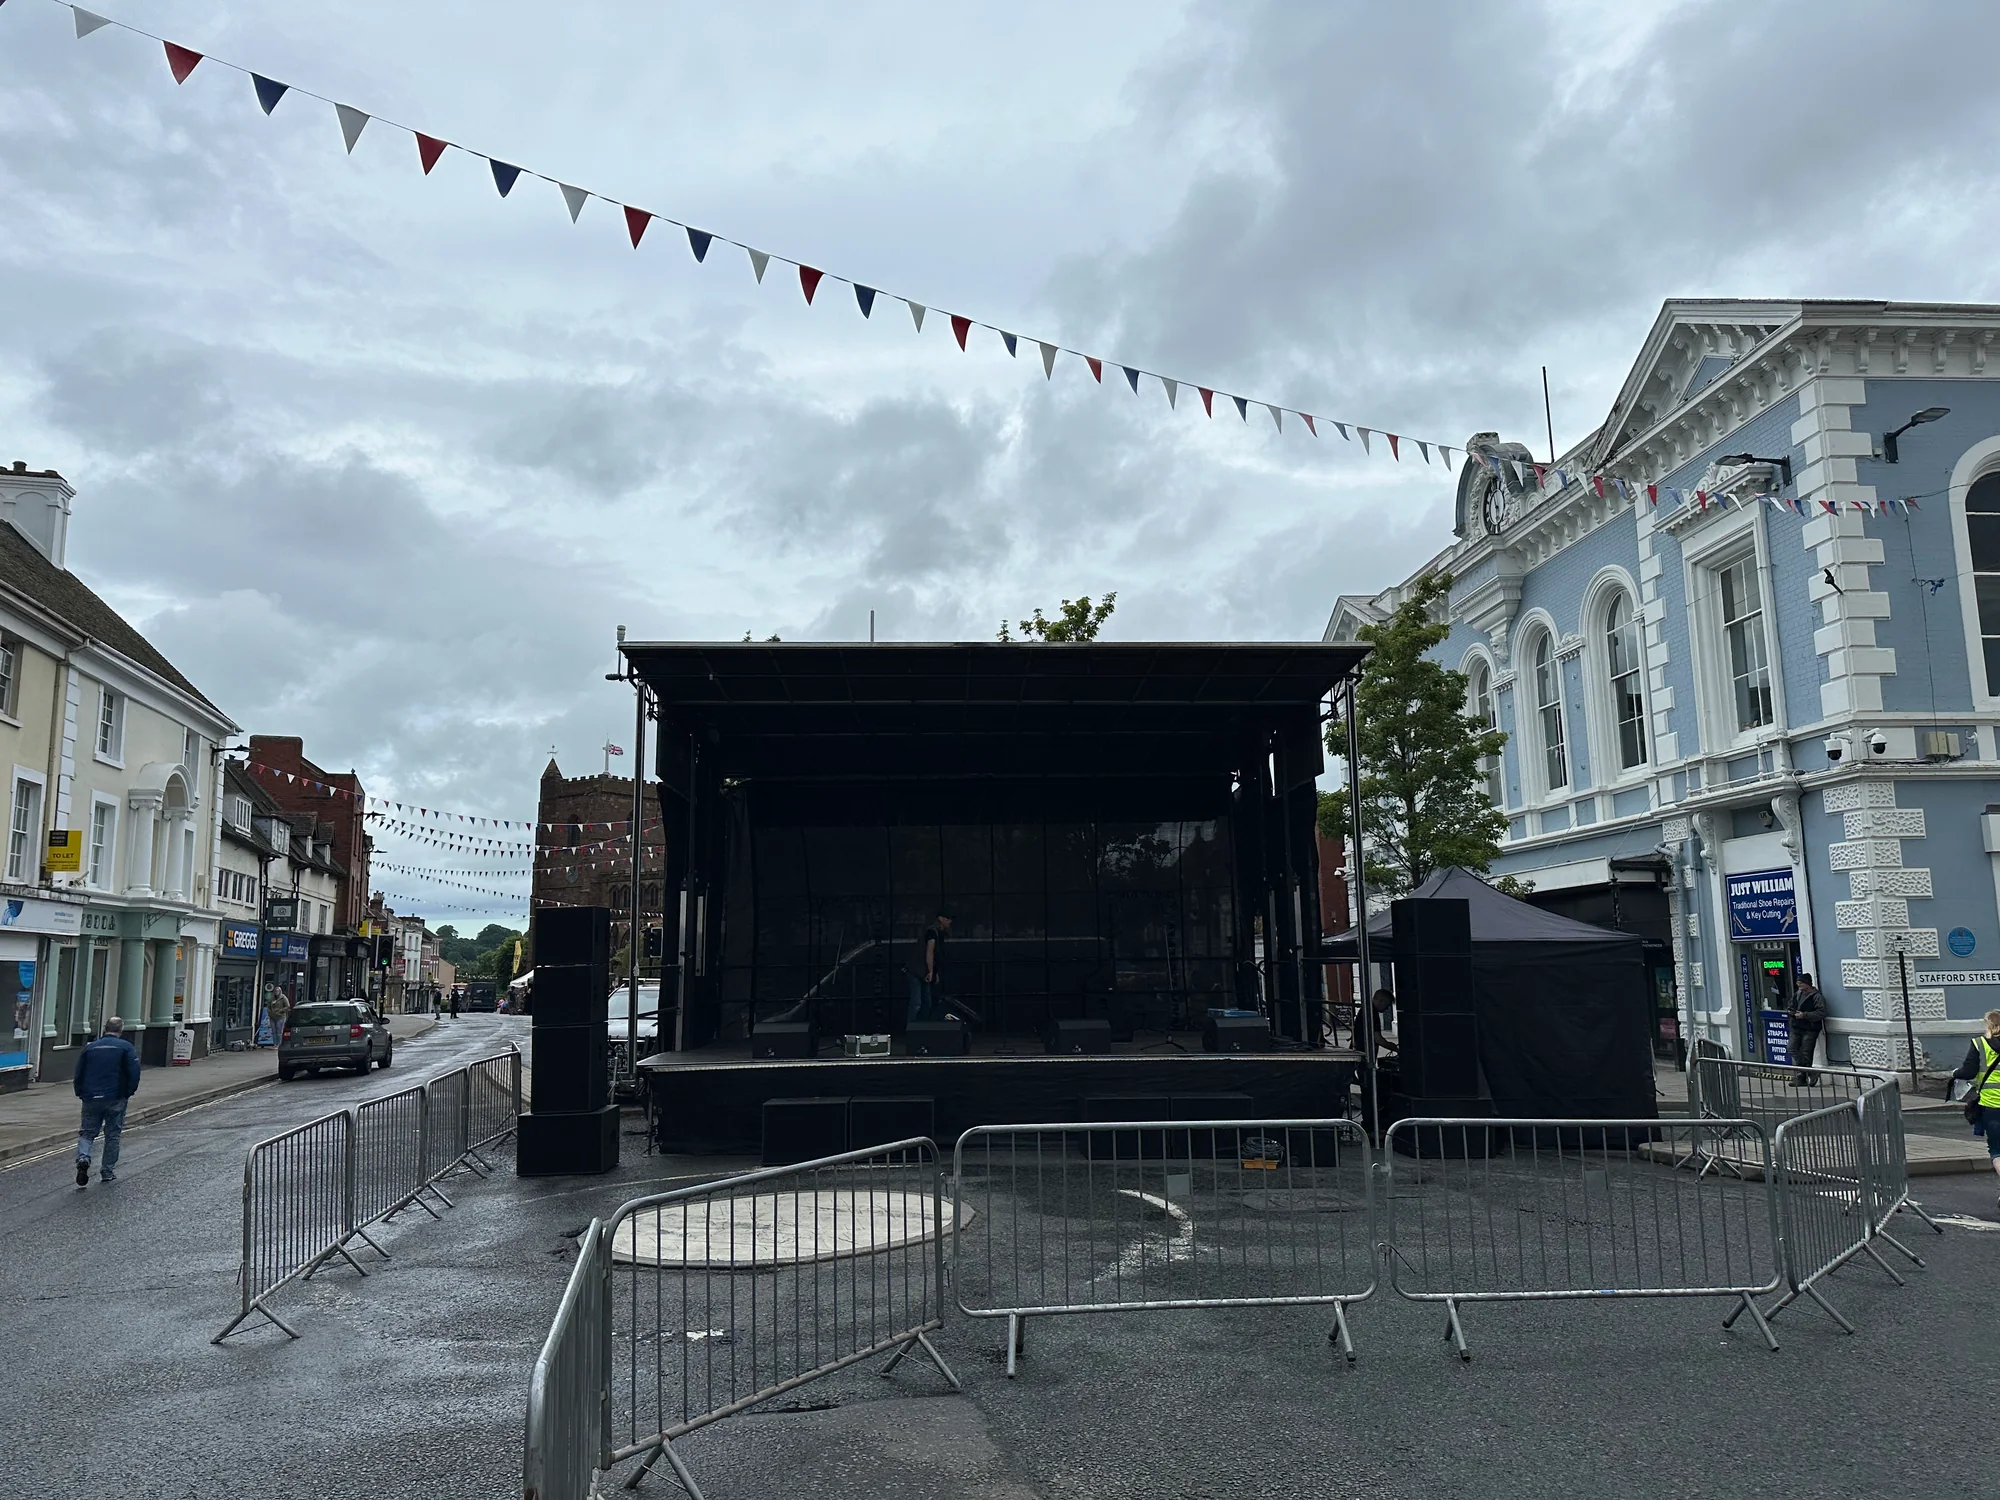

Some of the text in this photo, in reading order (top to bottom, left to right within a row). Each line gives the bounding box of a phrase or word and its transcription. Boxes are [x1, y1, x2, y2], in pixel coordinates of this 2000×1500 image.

[1730, 877, 1794, 897] JUST WILLIAM
[1732, 897, 1795, 910] Traditional Shoe Repairs
[1745, 910, 1781, 921] & Key Cutting
[233, 930, 258, 950] GREGGS
[1919, 974, 1966, 982] STAFFORD
